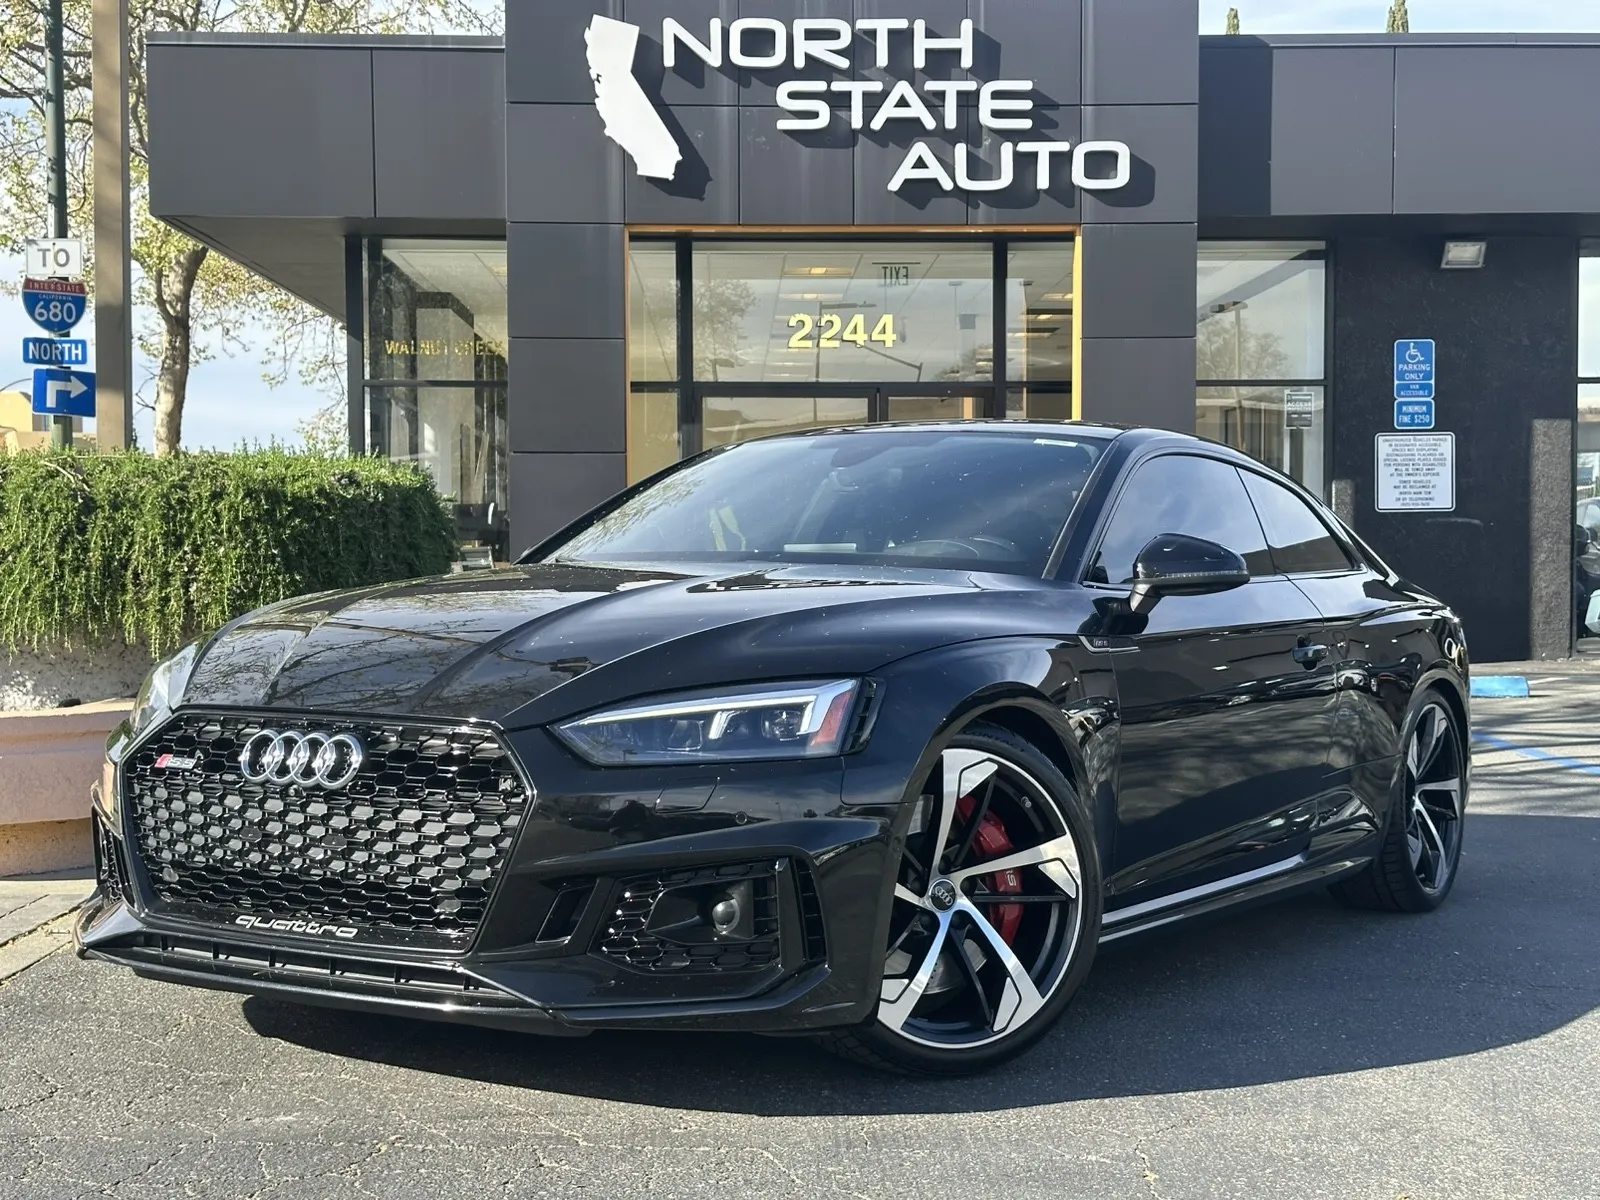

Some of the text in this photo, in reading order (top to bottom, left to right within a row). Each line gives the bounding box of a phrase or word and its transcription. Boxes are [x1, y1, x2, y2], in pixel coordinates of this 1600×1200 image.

[663, 18, 973, 69] NORTH
[776, 80, 1033, 130] STATE
[887, 141, 1130, 192] AUTO
[37, 248, 70, 268] TO
[30, 281, 81, 292] INTERSTATE
[34, 301, 76, 323] 680
[787, 313, 897, 349] 2244
[28, 342, 82, 361] NORTH
[1399, 414, 1430, 423] FINE $250
[235, 914, 358, 938] quattro
